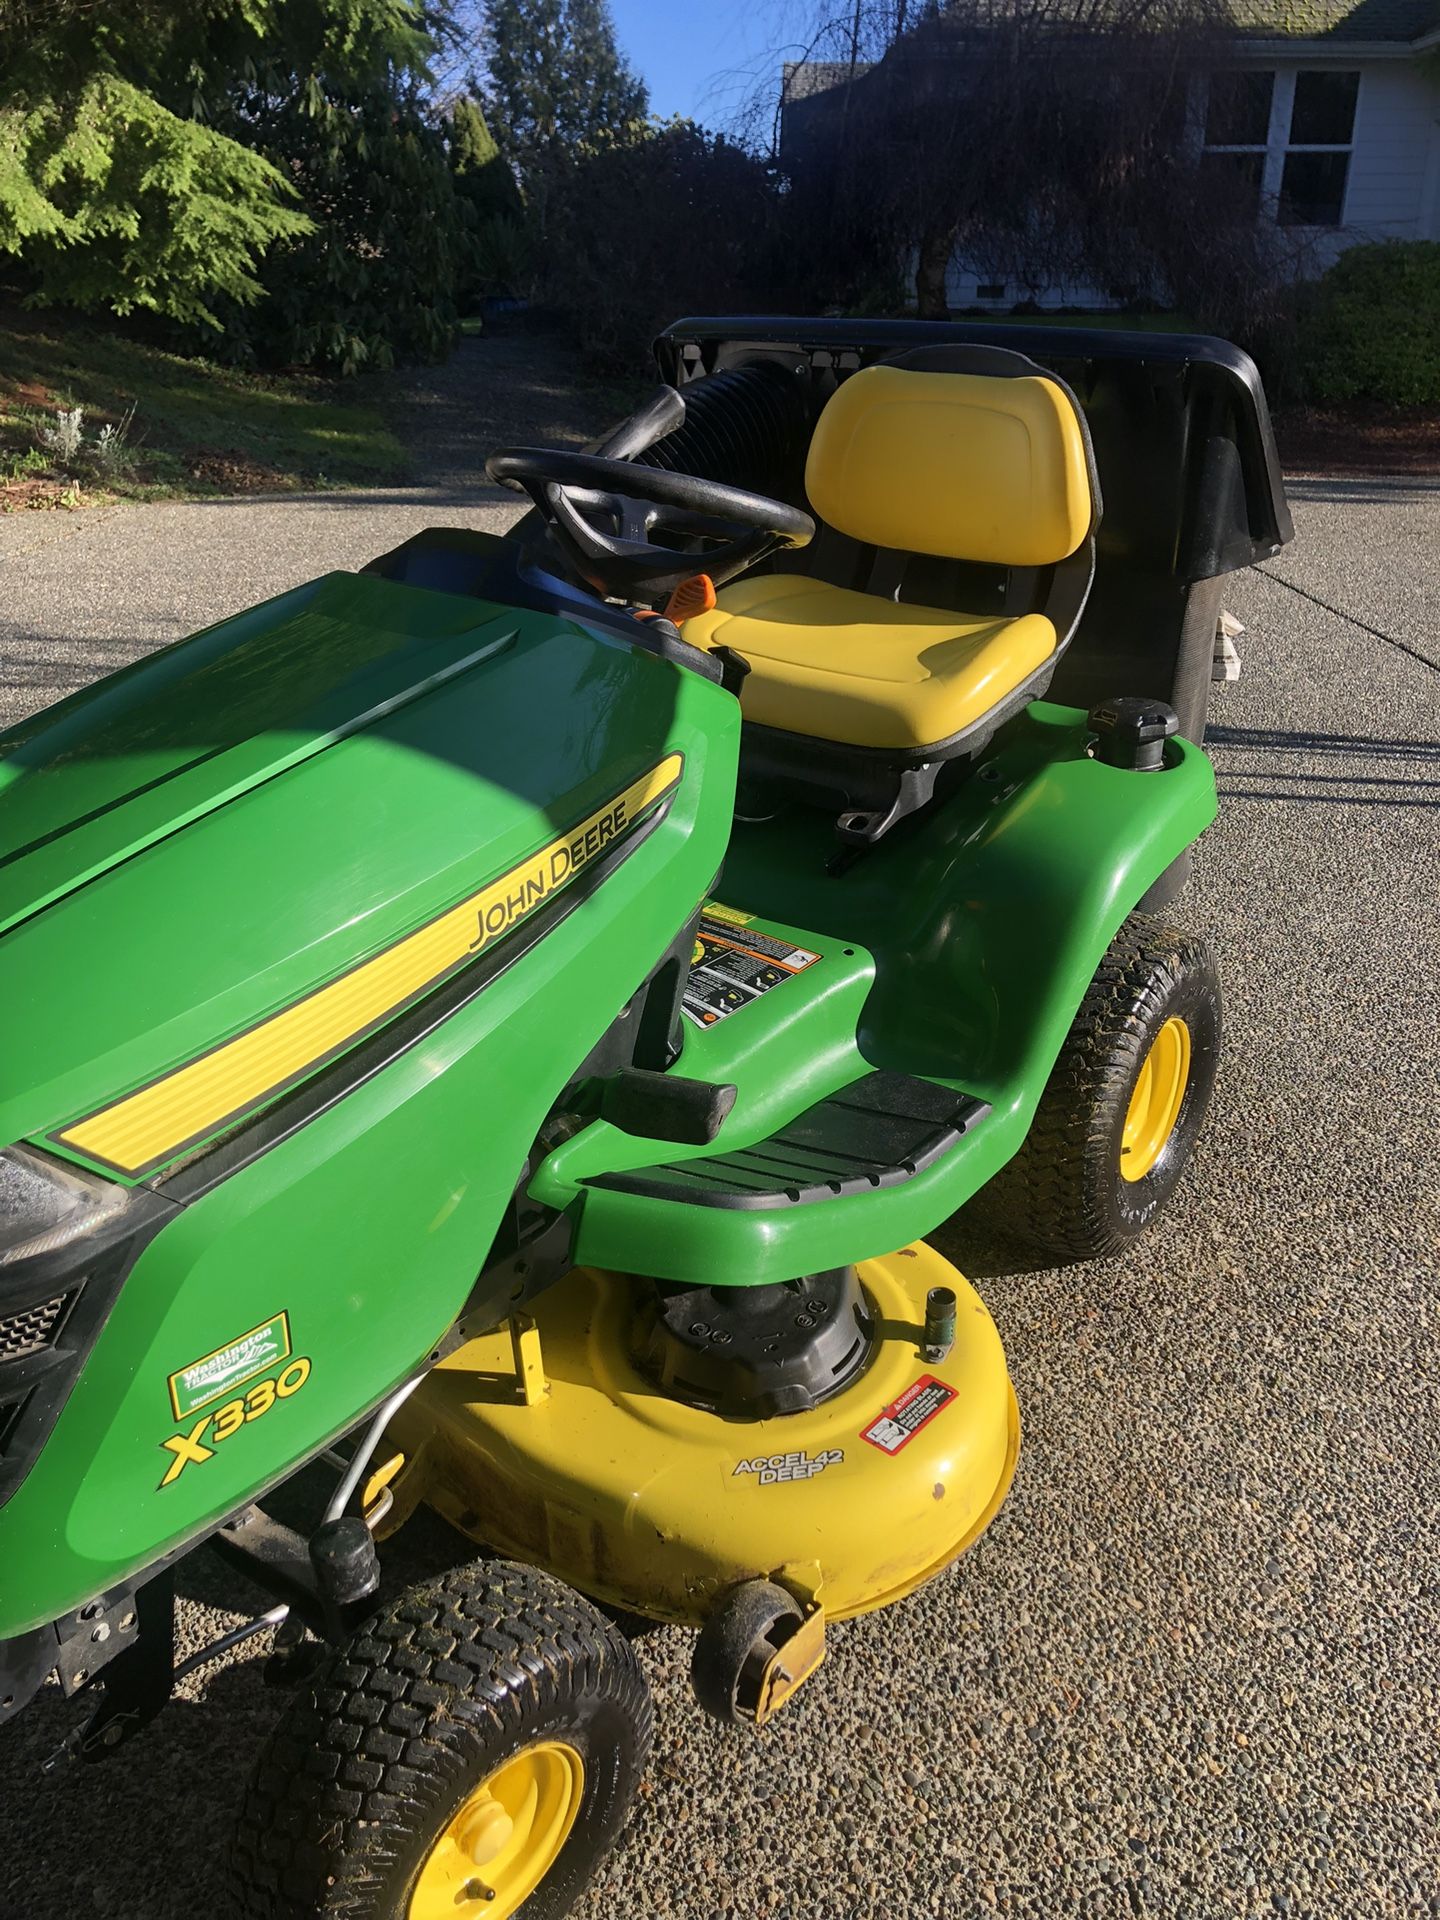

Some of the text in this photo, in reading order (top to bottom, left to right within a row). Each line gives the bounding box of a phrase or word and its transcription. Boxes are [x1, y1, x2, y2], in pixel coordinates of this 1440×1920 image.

[469, 800, 628, 950] JOHN DEERE
[182, 1327, 272, 1380] Washington
[184, 1354, 240, 1389] TRACTOR
[156, 1356, 312, 1491] X330
[732, 1451, 813, 1476] ACCEL
[759, 1463, 825, 1485] DEEP
